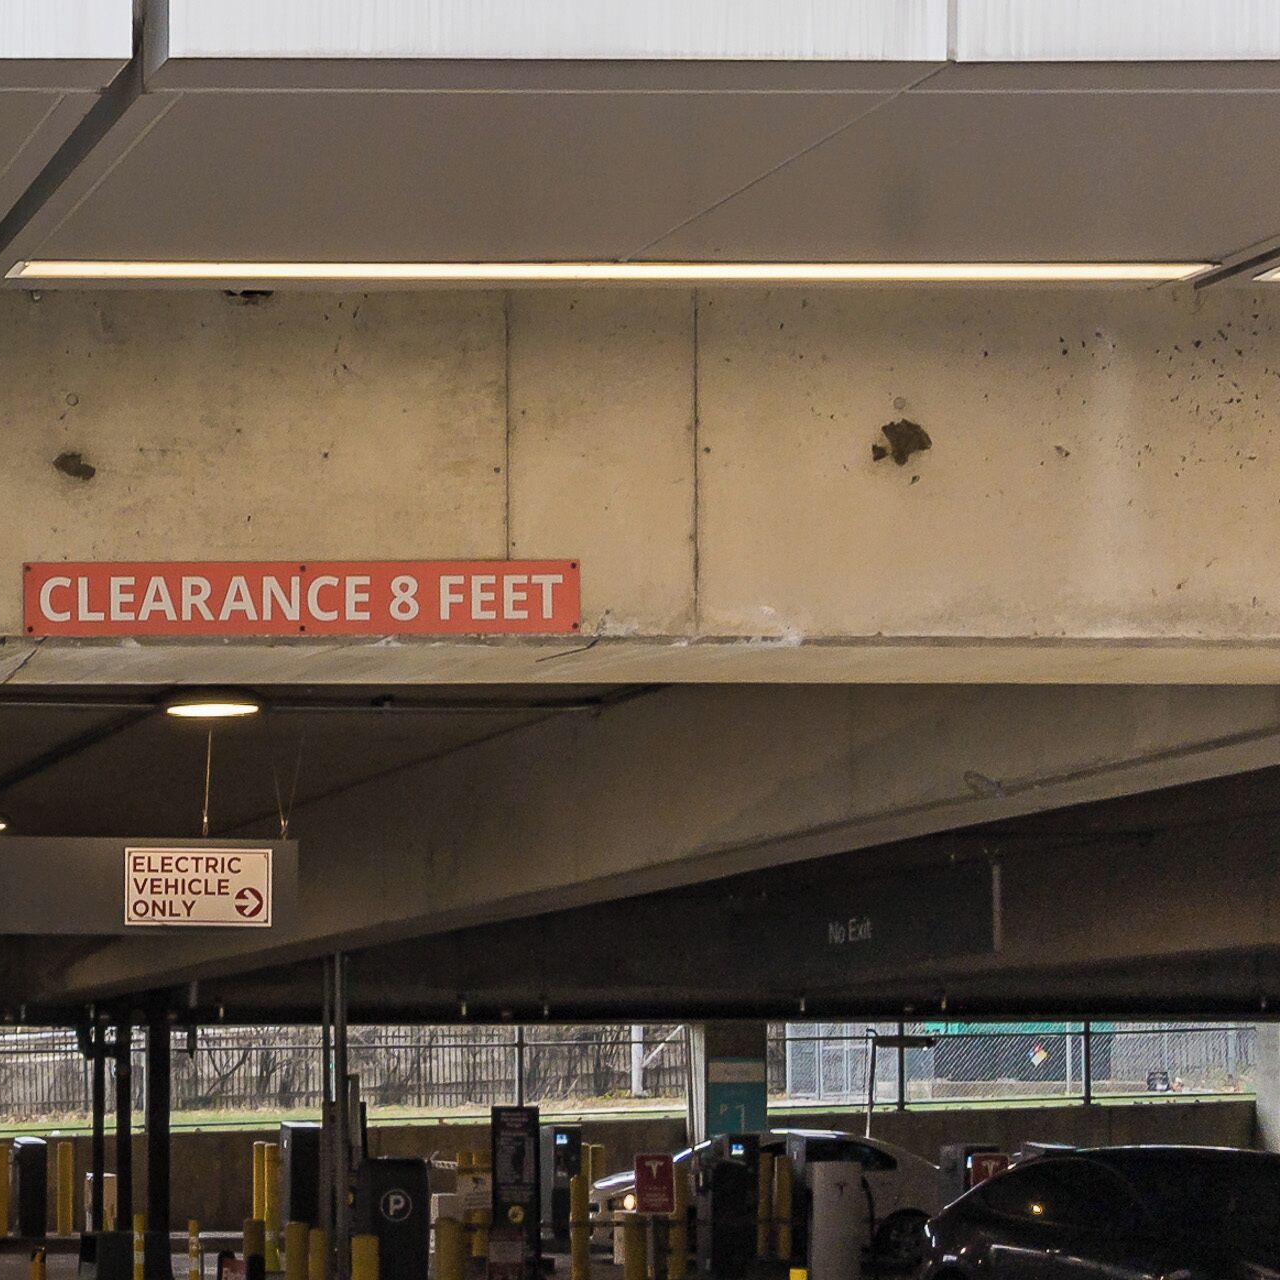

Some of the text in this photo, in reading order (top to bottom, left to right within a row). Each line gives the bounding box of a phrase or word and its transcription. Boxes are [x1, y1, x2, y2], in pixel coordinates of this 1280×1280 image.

[38, 575, 563, 622] CLEARANCE 8 FEET
[132, 856, 242, 874] ELECTRIC
[133, 878, 230, 896] VEHICLE
[132, 899, 196, 918] ONLY
